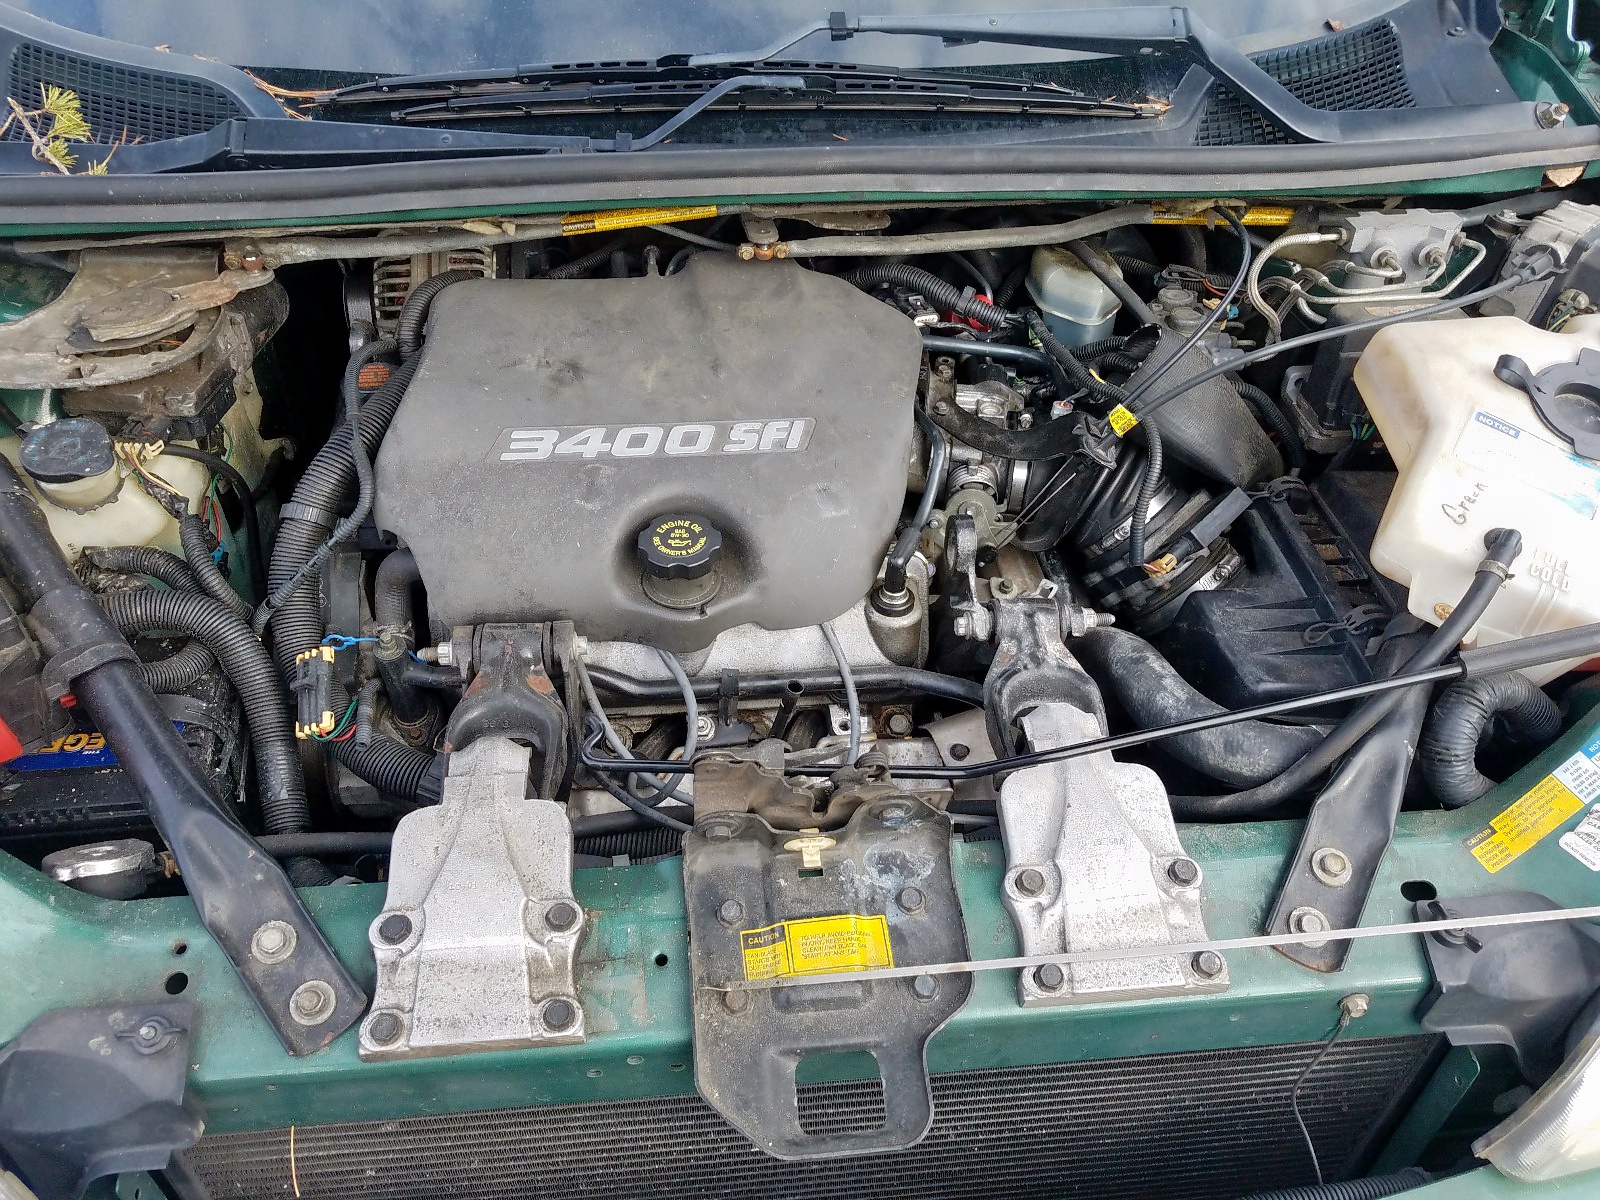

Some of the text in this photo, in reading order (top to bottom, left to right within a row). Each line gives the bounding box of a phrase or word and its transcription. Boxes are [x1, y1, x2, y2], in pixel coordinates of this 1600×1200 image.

[563, 221, 594, 232] CAUTION
[1478, 415, 1517, 438] NOTICE
[499, 420, 806, 461] 3400 SFI
[656, 520, 703, 534] ENGINE OIL
[652, 536, 662, 547] SEE
[687, 536, 707, 554] MANUAL
[1515, 794, 1533, 809] service
[1498, 823, 1510, 832] may
[1466, 828, 1492, 846] CAUTION
[1563, 841, 1572, 849] DO
[1571, 846, 1580, 855] NOT
[747, 931, 781, 945] CAUTION
